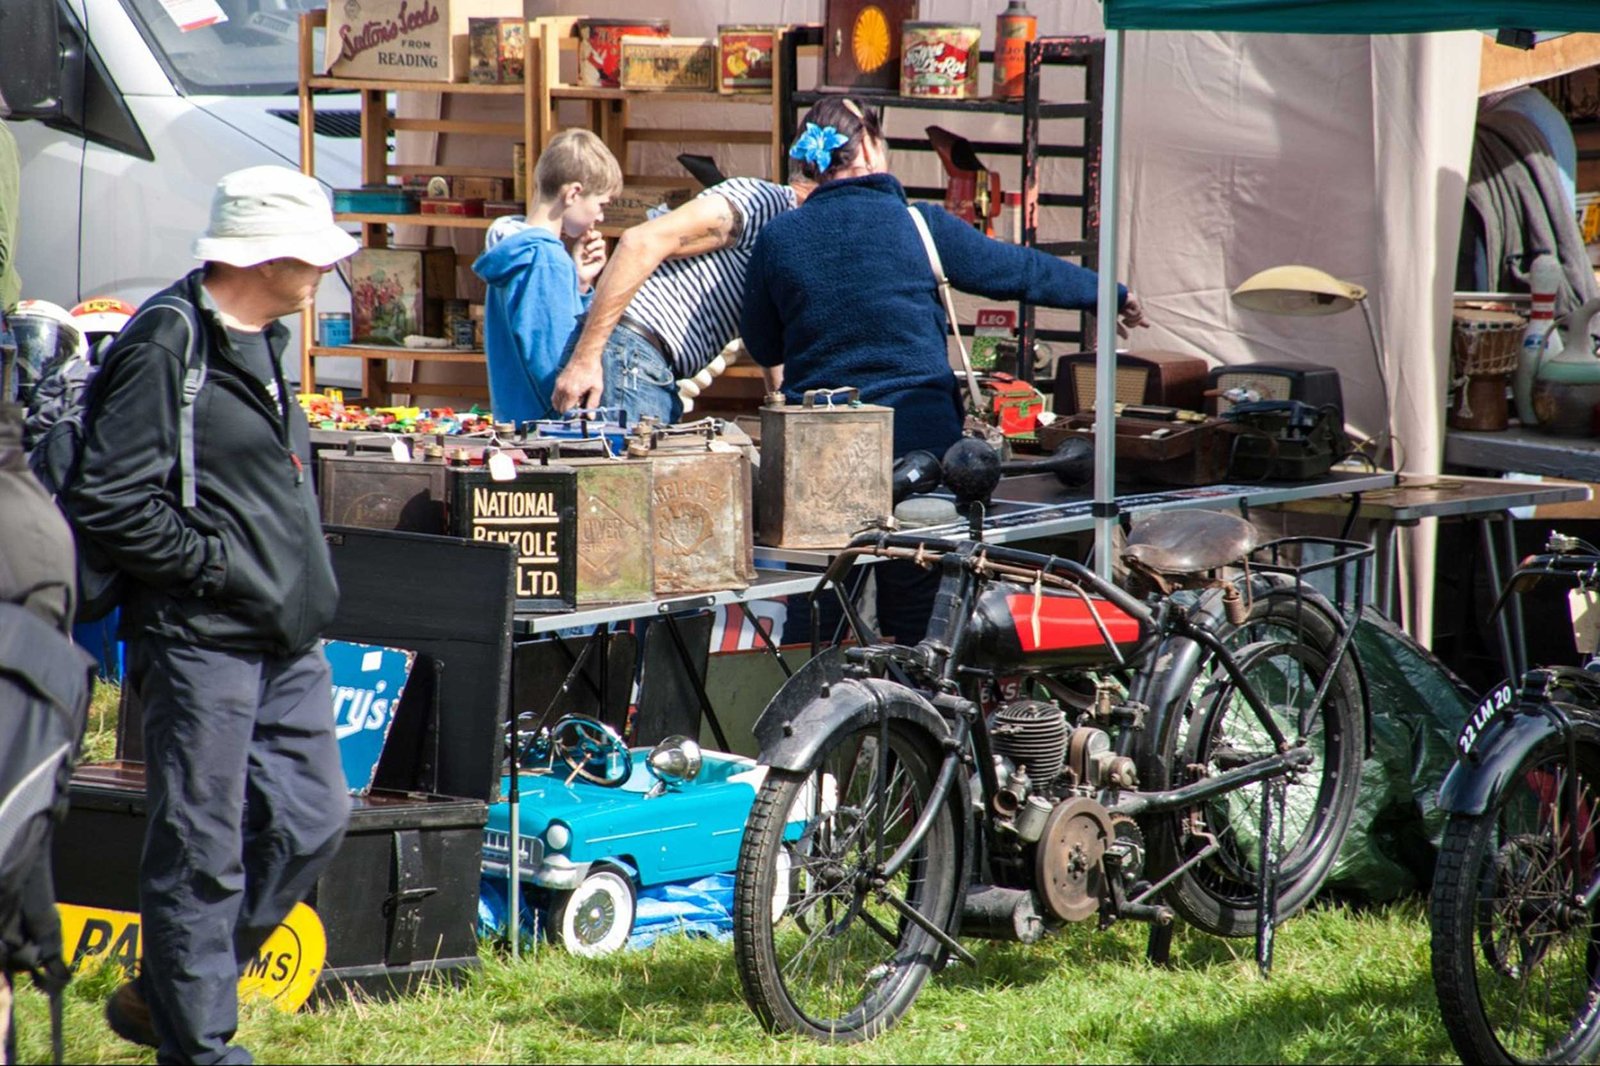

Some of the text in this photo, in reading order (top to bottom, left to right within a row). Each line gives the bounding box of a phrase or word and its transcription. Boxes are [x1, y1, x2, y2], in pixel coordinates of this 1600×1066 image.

[339, 20, 398, 62] Sutton's
[398, 0, 439, 34] Seeds
[401, 39, 432, 49] FROM
[378, 51, 438, 69] READING
[474, 487, 558, 517] NATIONAL
[516, 565, 560, 596] LTD.
[331, 679, 389, 740] ry's
[1460, 685, 1512, 754] 22 LM 20
[243, 951, 292, 981] MS
